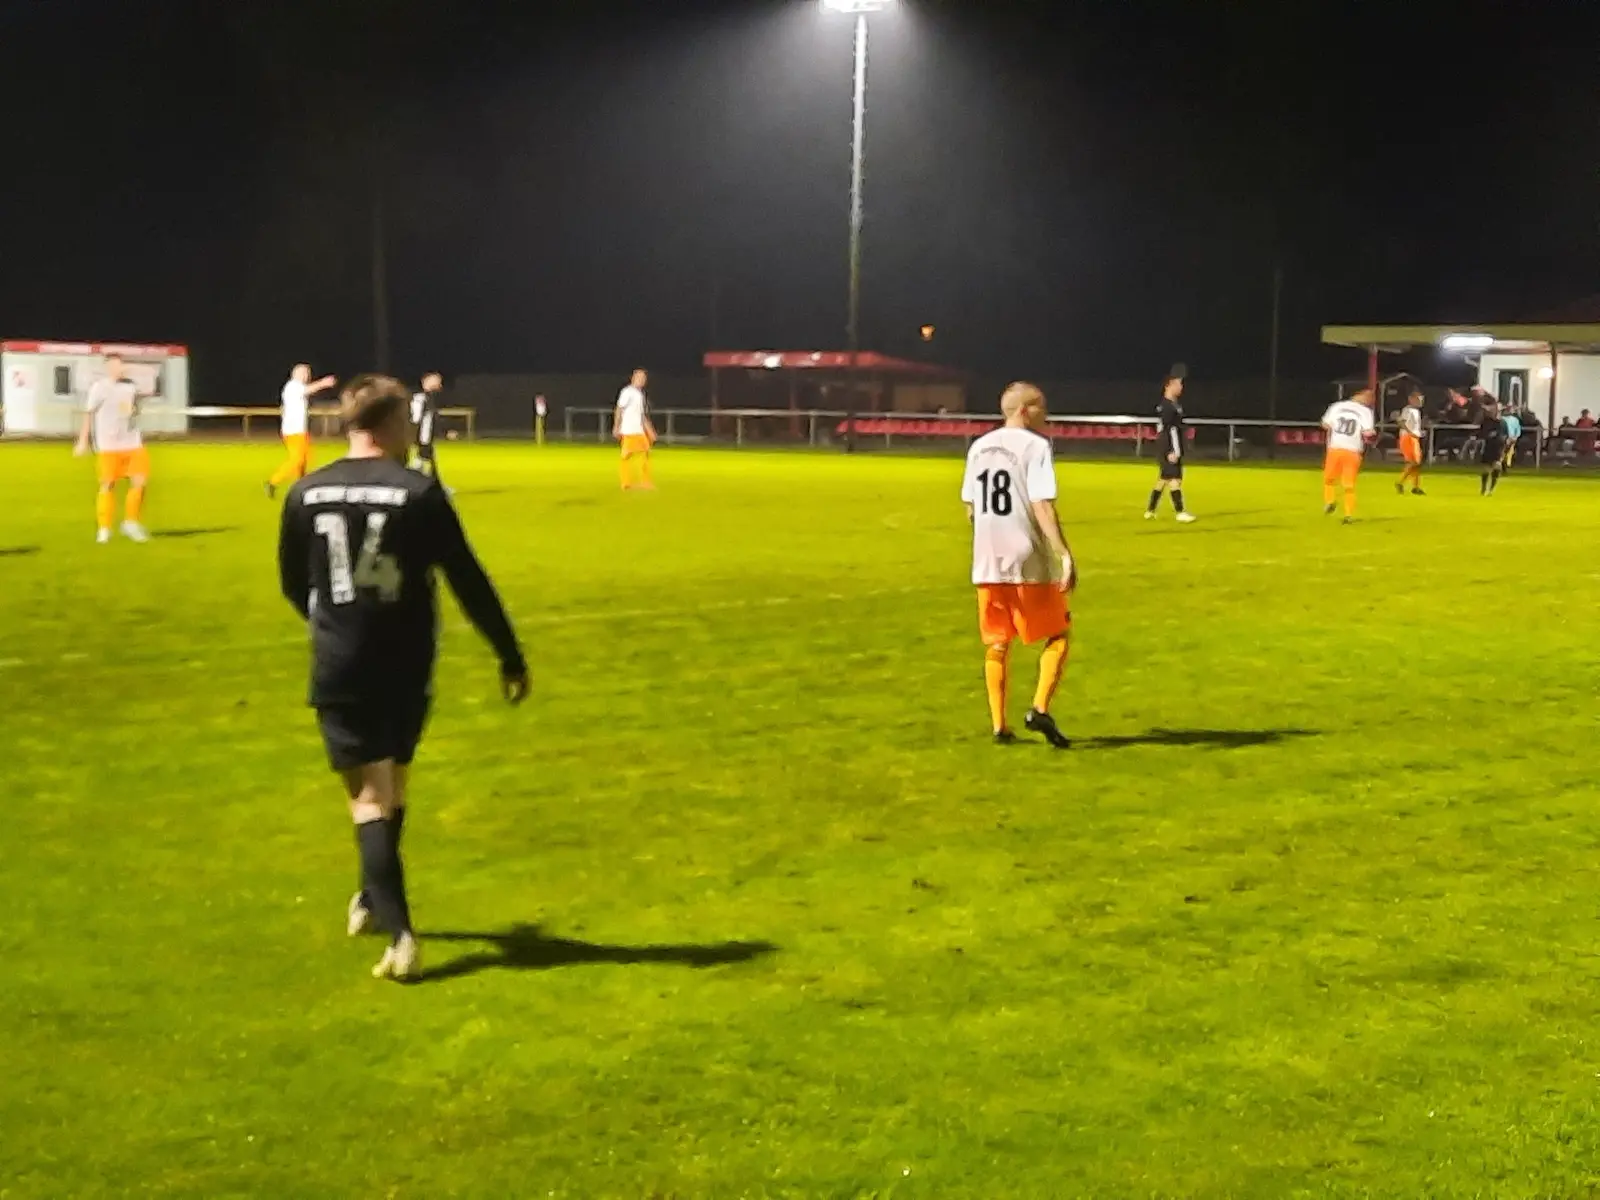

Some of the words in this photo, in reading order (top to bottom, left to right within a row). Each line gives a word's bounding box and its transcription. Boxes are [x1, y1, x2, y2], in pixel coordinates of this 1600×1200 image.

[1335, 417, 1357, 436] 20
[977, 468, 1012, 516] 18
[314, 513, 401, 604] 14
